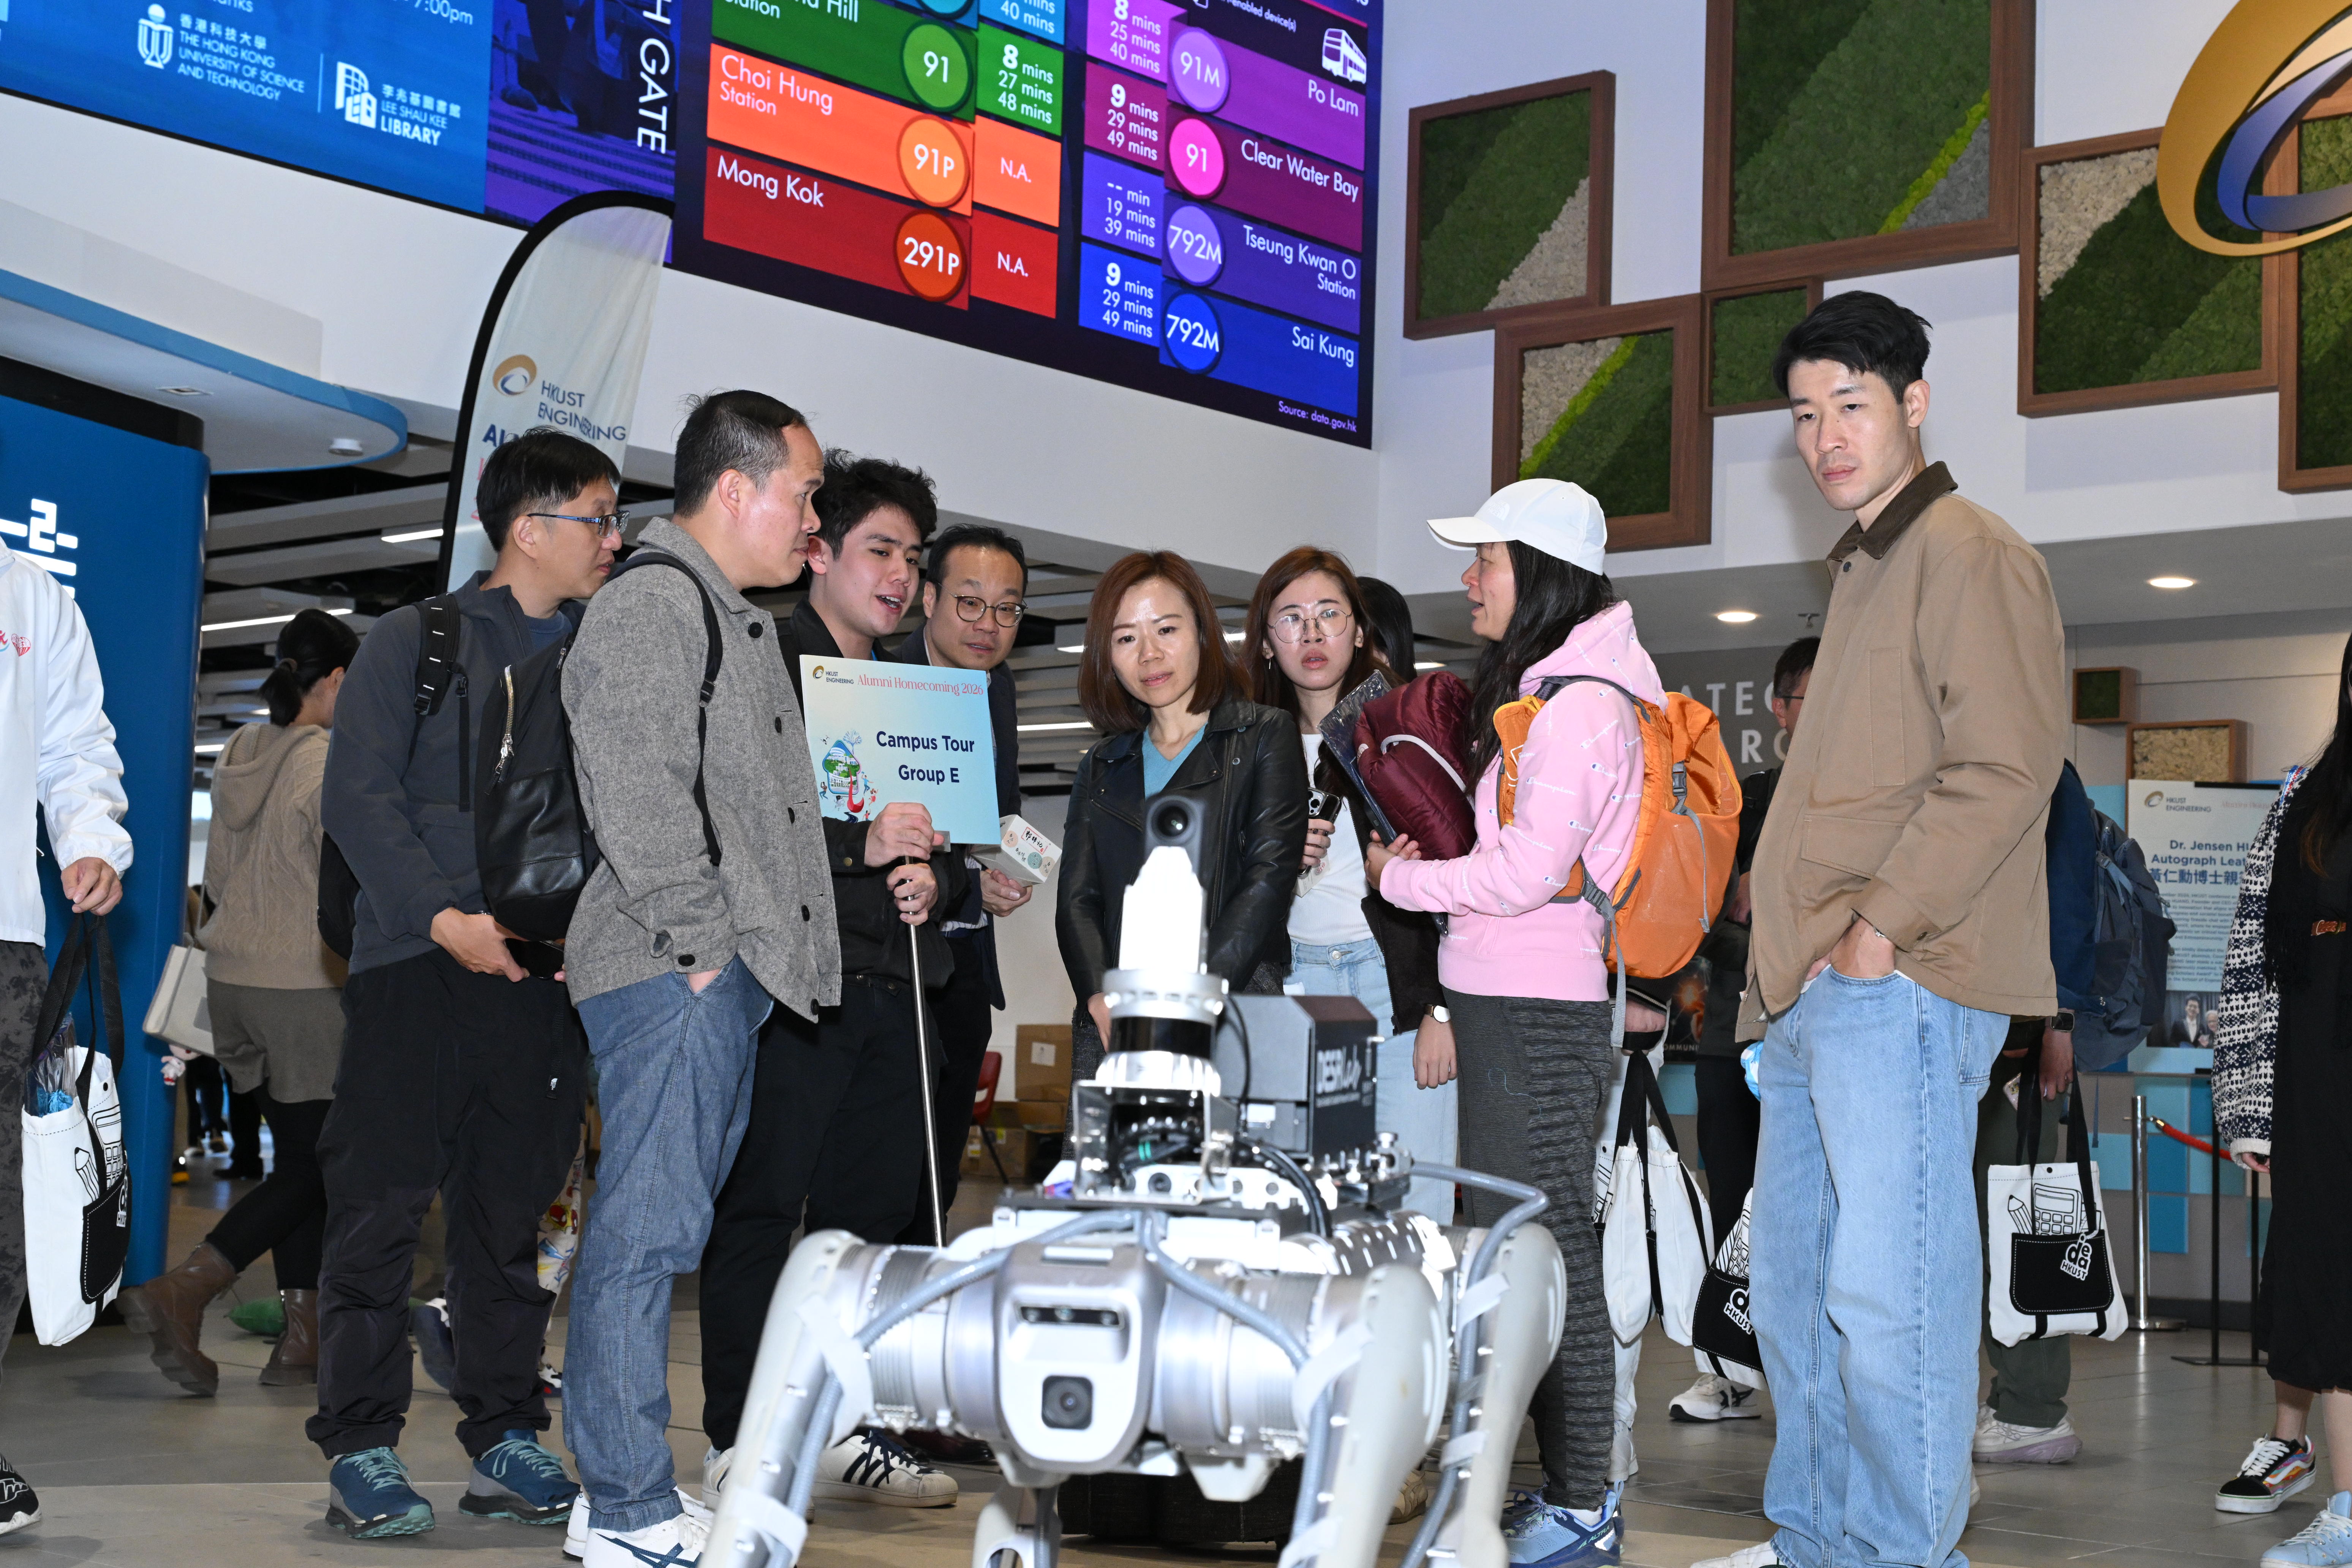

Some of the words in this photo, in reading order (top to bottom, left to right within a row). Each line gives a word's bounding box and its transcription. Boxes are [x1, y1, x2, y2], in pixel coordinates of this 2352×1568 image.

[725, 0, 780, 19] ation
[1001, 0, 1020, 20] 40
[1024, 13, 1055, 34] mins
[1132, 15, 1161, 35] mins
[1264, 9, 1296, 33] device(s)
[180, 13, 267, 50] 香港科技大學
[1110, 21, 1127, 41] 25
[1132, 34, 1160, 55] mins
[180, 30, 200, 47] THE
[202, 37, 239, 58] HONG
[240, 48, 275, 69] KONG
[1003, 44, 1019, 70] 8
[1022, 63, 1054, 85] mins
[1110, 41, 1127, 61] 40
[1131, 53, 1160, 74] mins
[178, 62, 204, 79] AND
[206, 70, 281, 101] TECHNOLOGY
[179, 46, 240, 74] UNIVERSITY
[242, 65, 258, 78] OF
[260, 70, 305, 93] SCIENCE
[923, 51, 948, 83] 91
[1181, 51, 1220, 88] 91M
[637, 38, 670, 154] GATE
[720, 81, 776, 115] Station
[721, 54, 771, 90] Choi
[779, 72, 833, 115] Hung
[998, 70, 1017, 90] 27
[1021, 83, 1053, 104] mins
[1308, 79, 1326, 104] Po
[1330, 88, 1359, 117] Lam
[381, 100, 397, 115] LEE
[399, 105, 428, 123] SHAU
[429, 114, 448, 129] KEE
[998, 91, 1017, 111] 48
[1021, 104, 1052, 125] mins
[1110, 84, 1126, 108] 9
[1129, 103, 1159, 123] mins
[381, 115, 441, 146] LIBRARY
[1107, 109, 1125, 129] 29
[1129, 122, 1158, 142] mins
[914, 144, 955, 178] 91P
[1107, 129, 1125, 148] 49
[1128, 141, 1157, 161] mins
[1186, 143, 1207, 172] 91
[717, 155, 778, 199] Mong
[786, 174, 824, 208] Kok
[1001, 157, 1032, 183] N.A.
[1241, 139, 1283, 171] Clear
[1287, 154, 1330, 187] Water
[1333, 171, 1359, 203] Bay
[1107, 197, 1123, 217] 19
[1126, 210, 1155, 228] mins
[1127, 190, 1150, 207] min
[1105, 217, 1122, 236] 39
[1126, 229, 1155, 248] mins
[1169, 224, 1222, 265] 792M
[904, 237, 959, 275] 291P
[997, 251, 1029, 277] N.A.
[1243, 224, 1293, 265] Tseung
[1298, 243, 1337, 274] Kwan
[1342, 259, 1356, 280] O
[1106, 262, 1121, 286] 9
[1125, 280, 1154, 299] mins
[1317, 273, 1356, 300] Station
[1103, 289, 1120, 308] 29
[1124, 300, 1153, 319] mins
[1102, 309, 1120, 328] 49
[1124, 319, 1153, 338] mins
[1167, 314, 1219, 352] 792M
[1292, 326, 1314, 351] Sai
[1319, 334, 1354, 368] Kung
[541, 380, 585, 408] HKUST
[1278, 400, 1309, 419] Source:
[1311, 410, 1357, 433] data.gov.hk
[857, 674, 892, 688] Alumni
[895, 677, 960, 696] Homecoming
[961, 683, 983, 695] 2026
[876, 731, 937, 752] Campus
[942, 735, 975, 752] Tour
[898, 764, 945, 785] Group
[950, 768, 959, 783] E
[1526, 777, 1577, 795] Champion
[2152, 854, 2217, 867] Autograph
[2221, 856, 2246, 866] Leat
[2170, 840, 2186, 850] Dr.
[2191, 841, 2233, 852] Jensen
[2062, 1261, 2086, 1279] HKUST
[1725, 1304, 1753, 1333] HKUST
[1588, 1525, 1609, 1543] ALTRA
